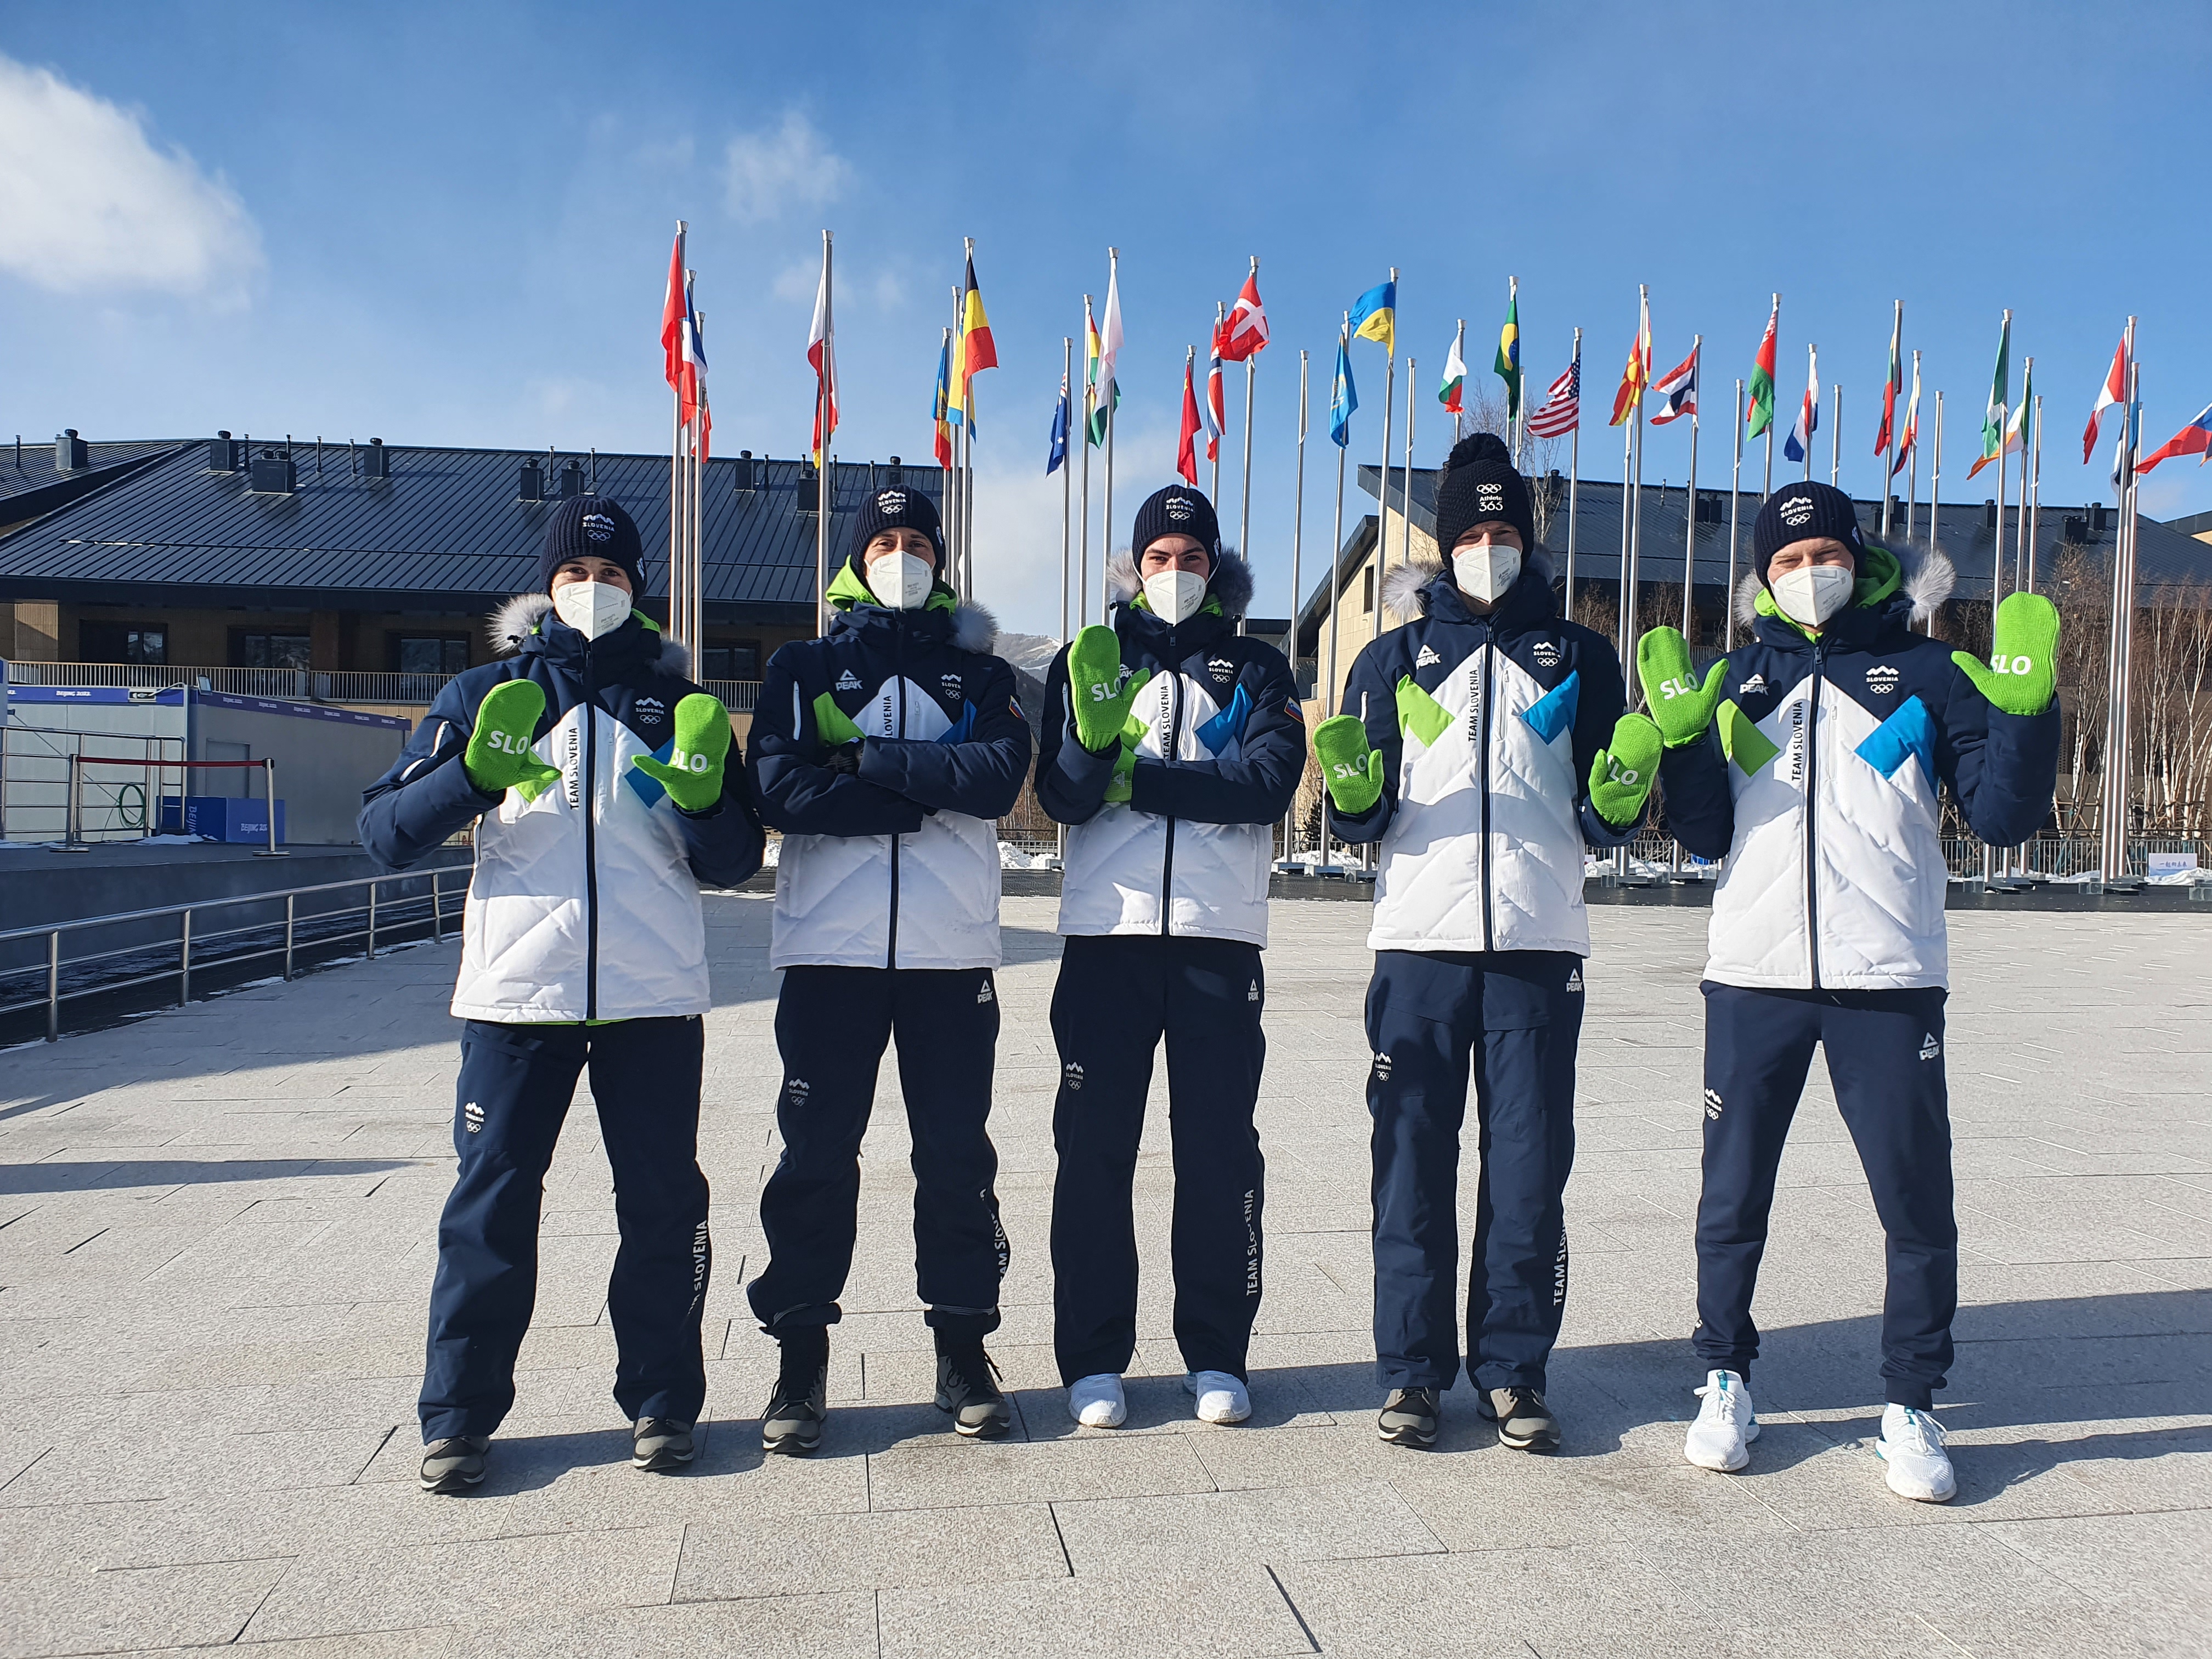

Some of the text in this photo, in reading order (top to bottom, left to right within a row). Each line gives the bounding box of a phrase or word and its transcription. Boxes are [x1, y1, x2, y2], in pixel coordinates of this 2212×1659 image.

[878, 498, 906, 507] SLOVENIA
[1479, 501, 1503, 512] 365
[1780, 505, 1814, 518] SLOVENIA
[582, 522, 614, 532] SLOVENIA
[1415, 654, 1441, 670] PEAK
[1991, 654, 2032, 675] SLO
[835, 680, 864, 692] PEAK
[1091, 676, 1123, 702] SLO
[1660, 673, 1698, 700] SLO
[1739, 684, 1769, 696] PEAK
[883, 695, 893, 737] LOVENIA
[1468, 669, 1479, 742] TEAM SLOVENIA
[1160, 686, 1171, 759] TEAM SLOVENIA
[487, 730, 528, 754] SLO
[1791, 702, 1803, 781] TEAM SLOVENIA
[568, 727, 579, 810] TEAM SLOVENIA
[672, 747, 708, 772] SLO
[1333, 754, 1368, 778] SLO
[186, 806, 197, 833] BEIJIN
[978, 991, 993, 1004] PEAK
[1566, 982, 1583, 992] PEAK
[692, 1220, 708, 1291] SLOVENIA
[1246, 1258, 1258, 1296] TEAM
[1553, 1264, 1565, 1306] TEAM
